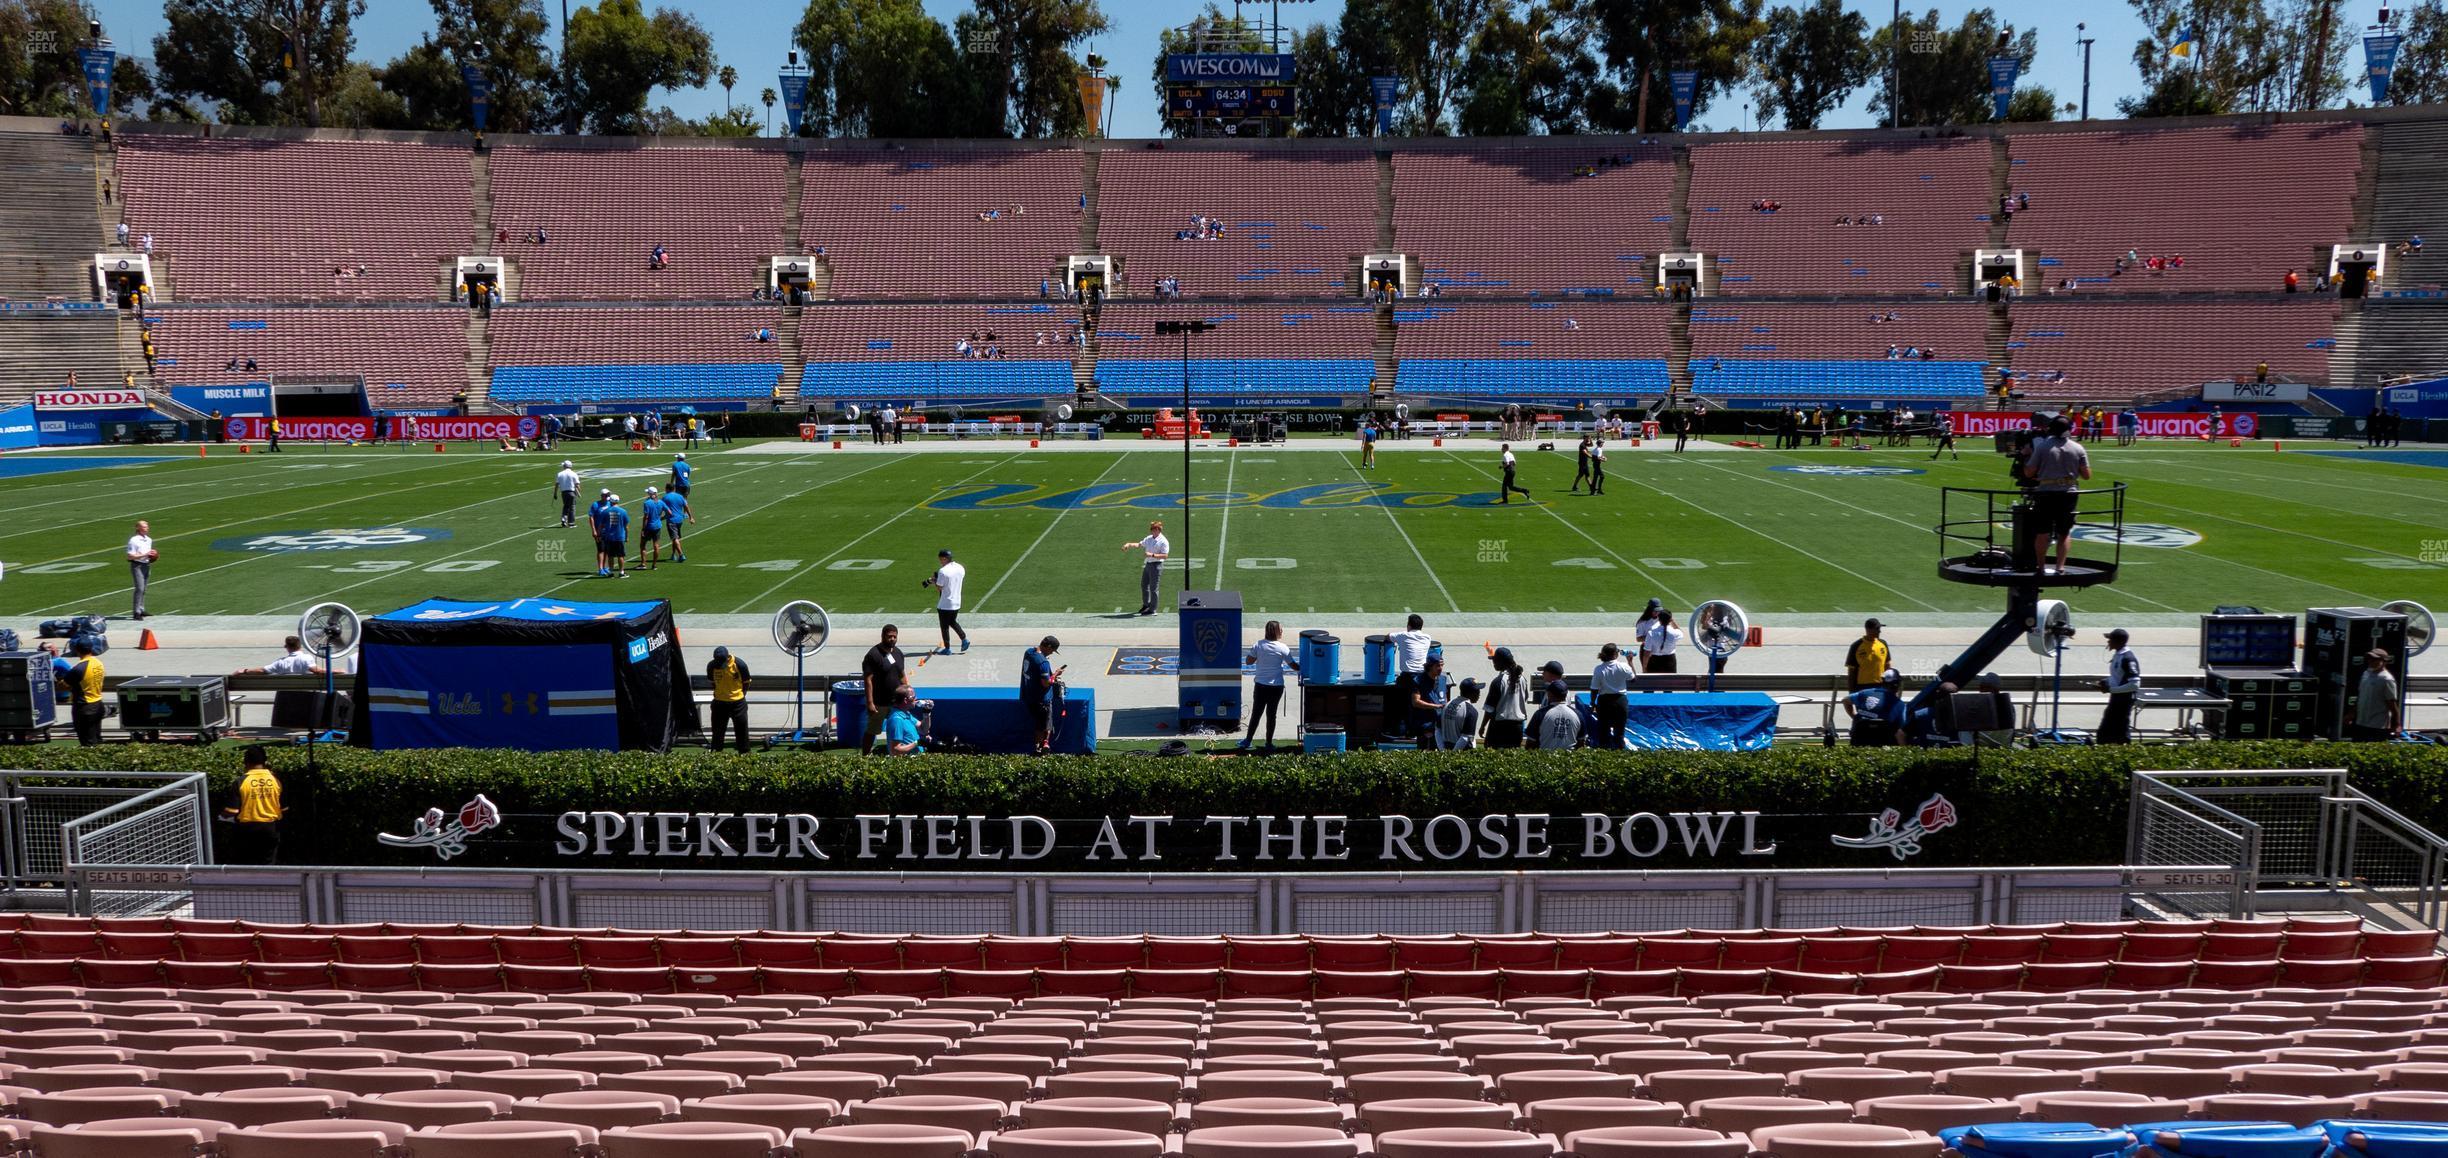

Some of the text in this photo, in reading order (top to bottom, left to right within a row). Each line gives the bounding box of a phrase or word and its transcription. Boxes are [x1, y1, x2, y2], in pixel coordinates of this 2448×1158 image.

[1180, 58, 1259, 75] WESCOM
[1216, 89, 1247, 100] 64:34
[1185, 99, 1192, 109] 0
[1270, 99, 1277, 109] 0
[37, 392, 144, 406] HONDA
[204, 388, 266, 399] MUSCLE MILK
[67, 421, 97, 430] Health
[2113, 414, 2226, 434] Isurance
[2386, 622, 2400, 631] F2
[631, 632, 668, 658] UCLA Health
[438, 691, 482, 715] Ucla
[250, 778, 273, 788] CSC
[556, 810, 1777, 861] SPIEKER FIELD AT THE ROSE BOWL
[89, 872, 169, 883] SEATS 101-130
[2164, 874, 2232, 885] SEATS 1-30
